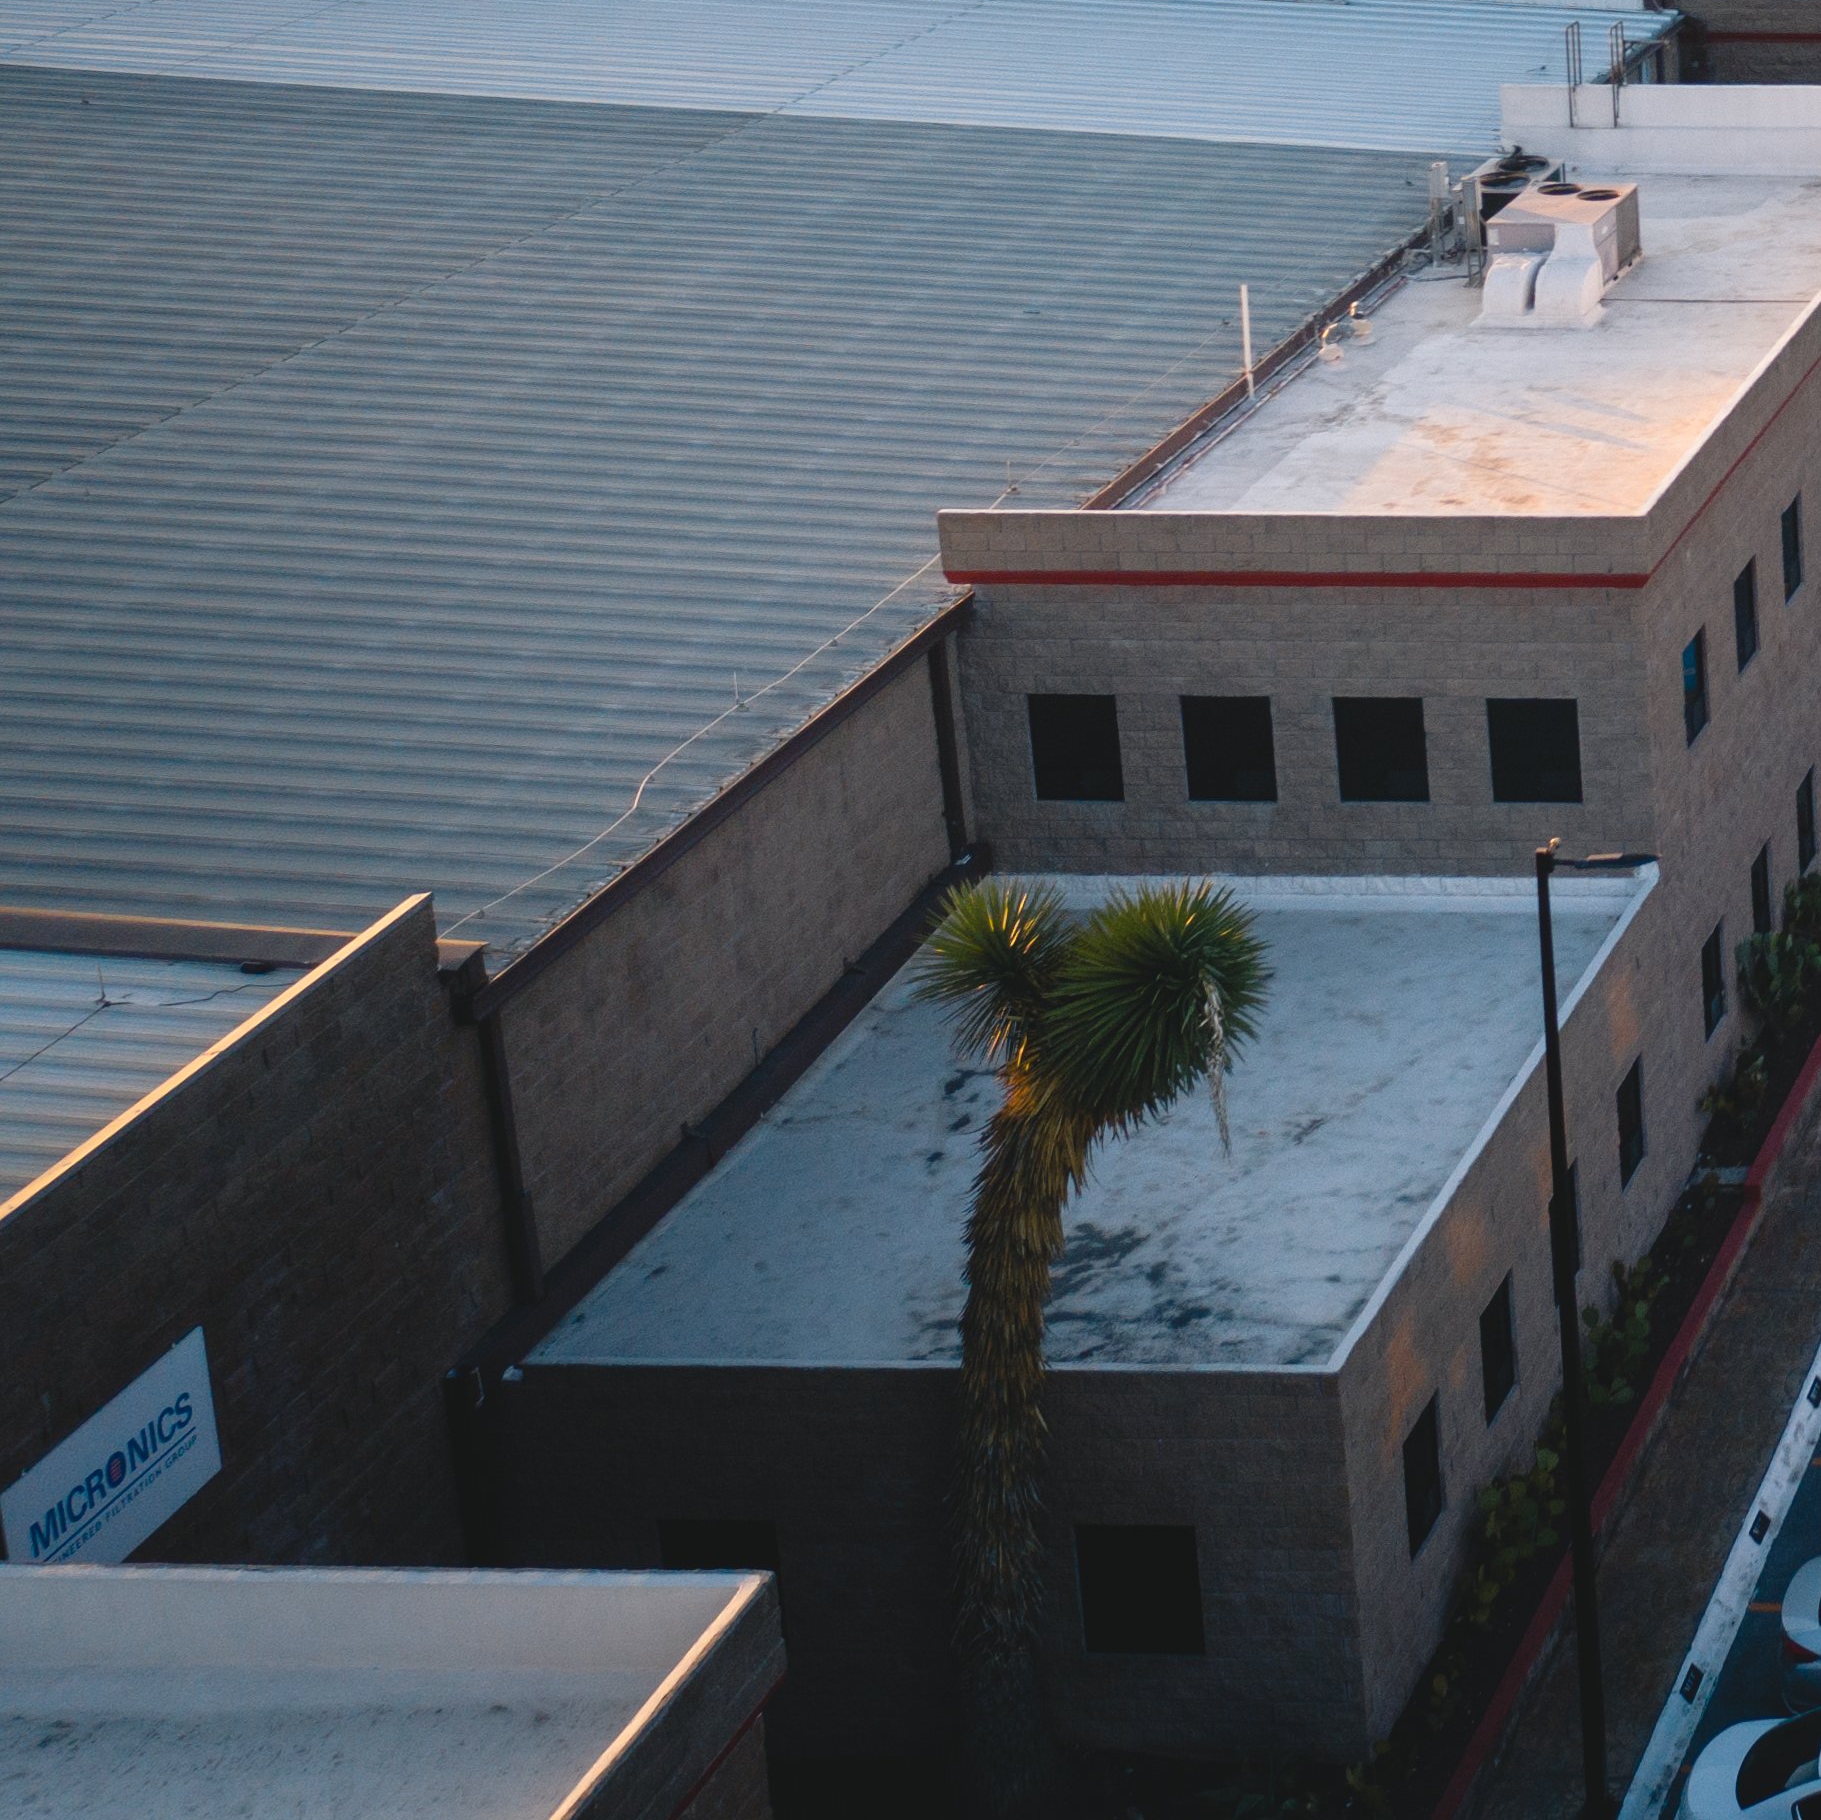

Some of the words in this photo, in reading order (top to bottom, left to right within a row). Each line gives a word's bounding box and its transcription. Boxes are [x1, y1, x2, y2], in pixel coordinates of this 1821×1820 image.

[29, 1391, 194, 1558] MICRONICS
[53, 1521, 102, 1563] INEERED
[105, 1469, 162, 1521] FILTRATION
[165, 1434, 198, 1468] GROUP
